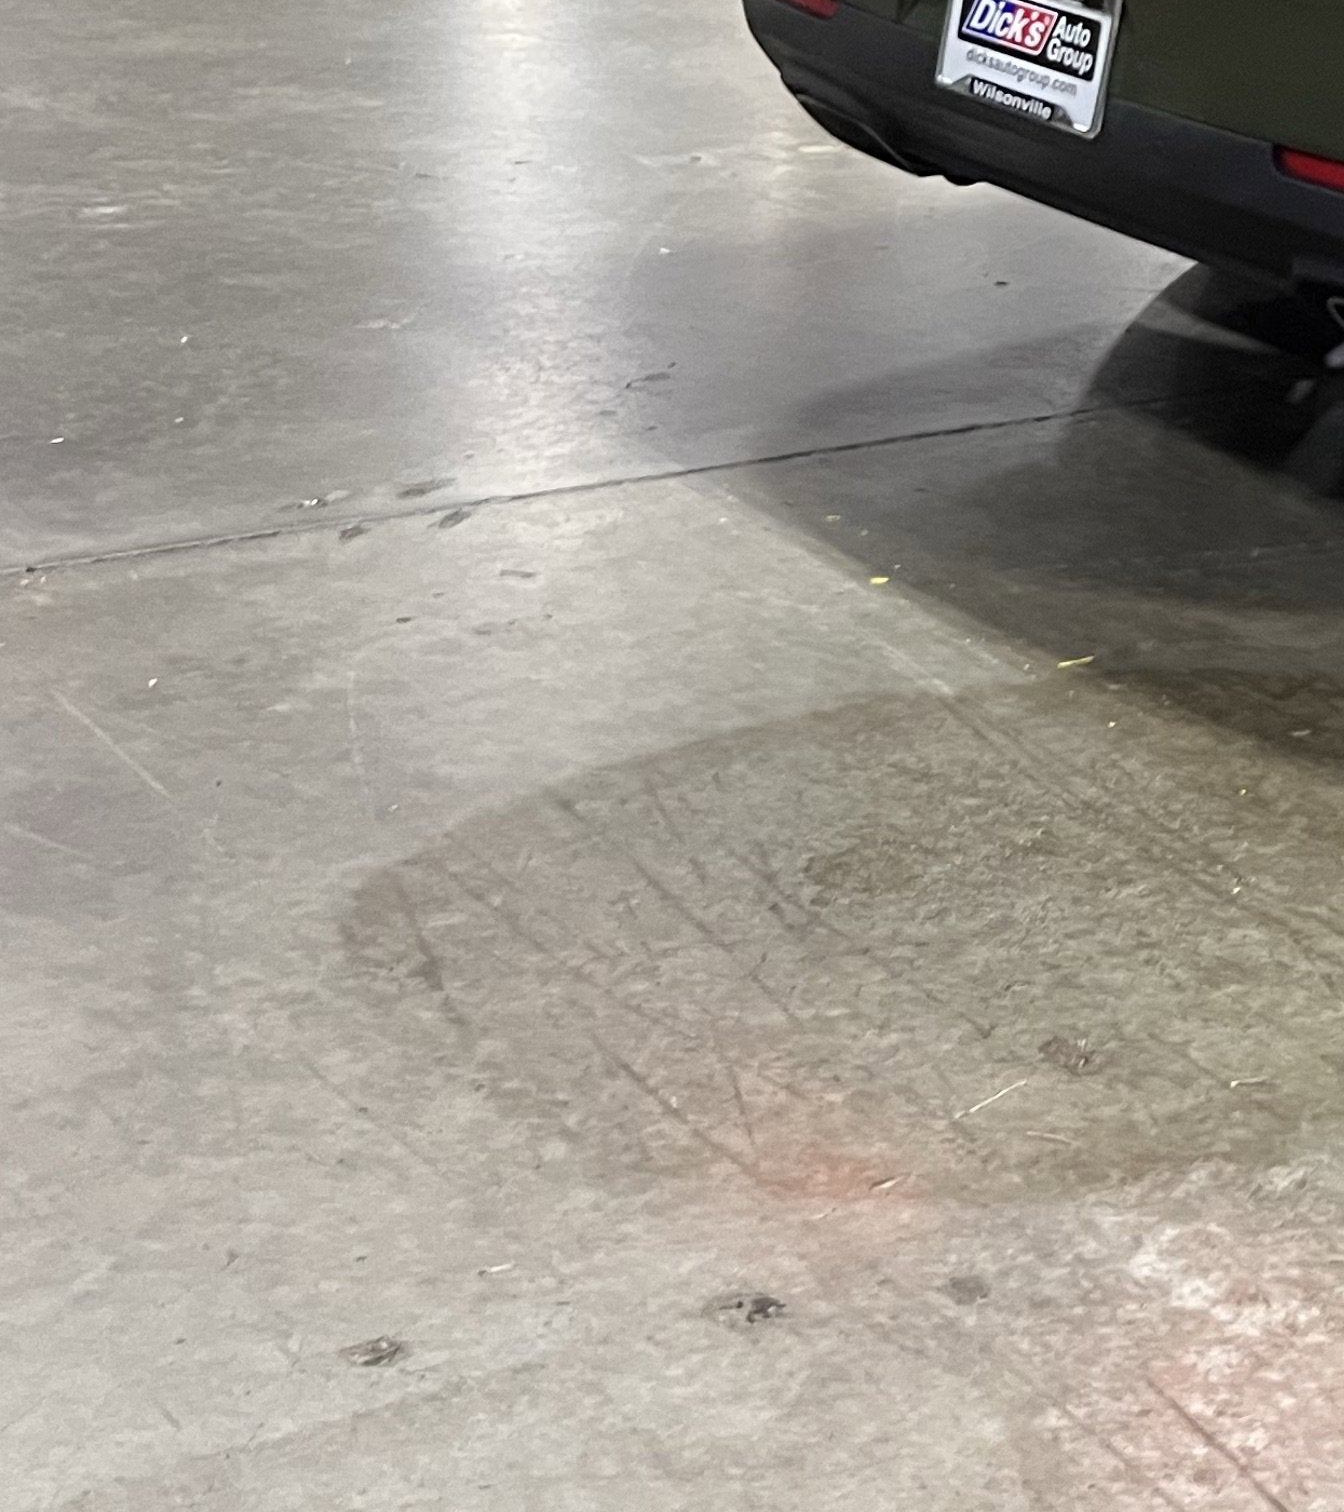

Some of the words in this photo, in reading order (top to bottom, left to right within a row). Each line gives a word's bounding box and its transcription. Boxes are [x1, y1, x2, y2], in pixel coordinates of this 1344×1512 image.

[1051, 15, 1092, 49] Auto
[965, 47, 1078, 97] dicksautogroup.com
[1046, 37, 1094, 76] Group
[971, 78, 1052, 120] Wilsonville
